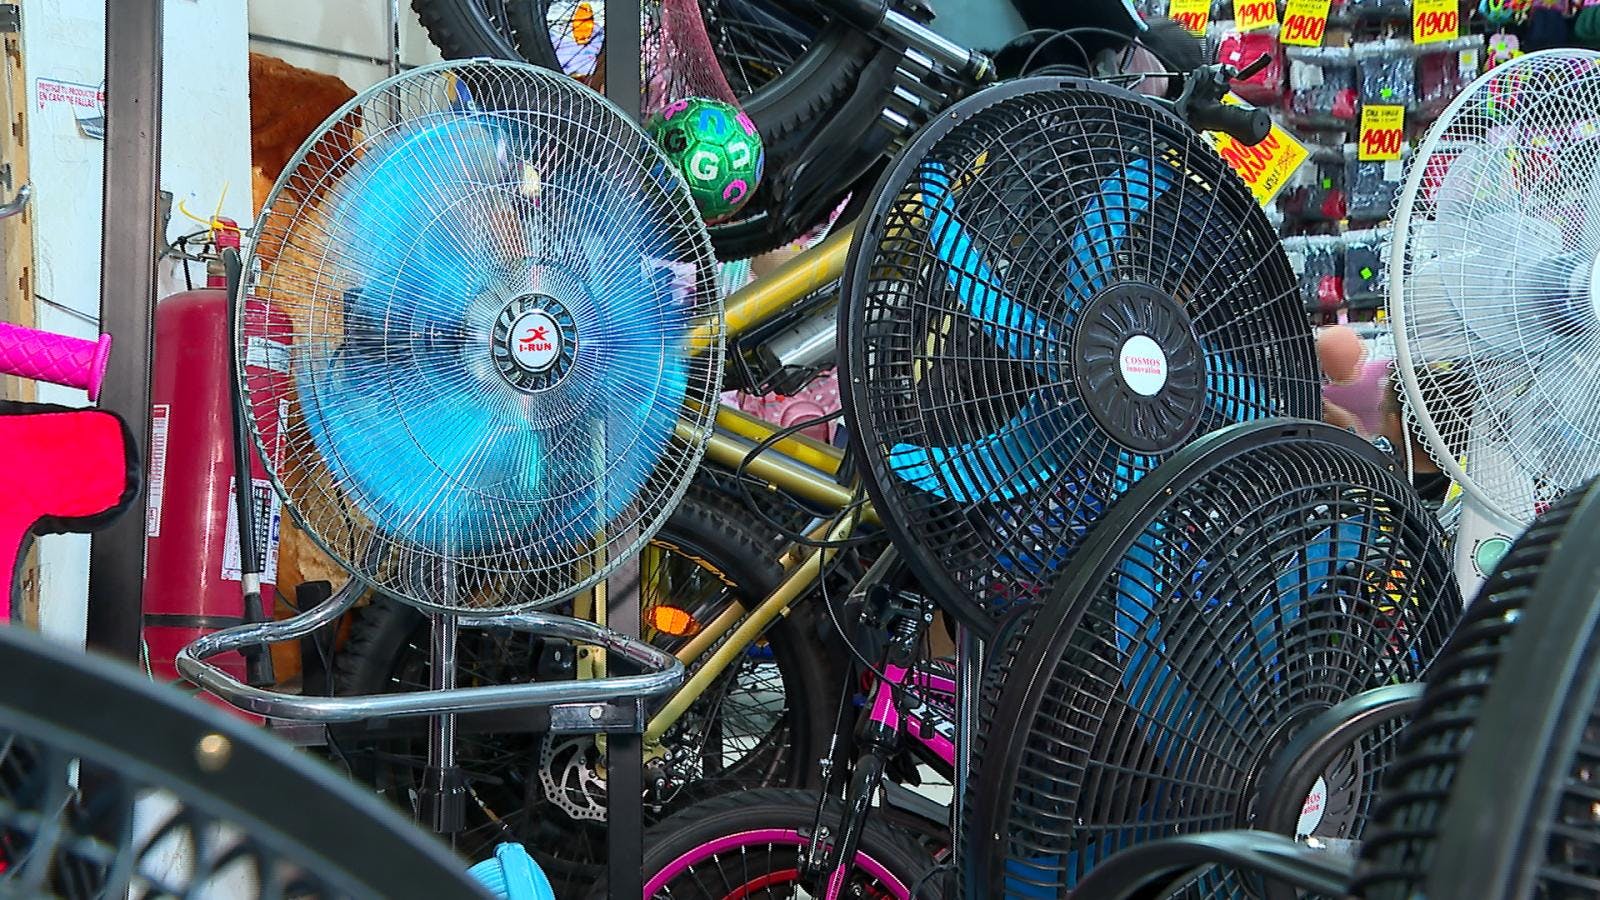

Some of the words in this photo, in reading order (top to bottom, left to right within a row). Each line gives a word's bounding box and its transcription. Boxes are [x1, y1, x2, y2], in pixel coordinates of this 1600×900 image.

[1238, 2, 1275, 27] 1900
[1416, 11, 1456, 38] 1900
[1285, 14, 1325, 41] 1900
[74, 96, 96, 108] FALLAS
[1362, 128, 1402, 155] 1900
[690, 150, 720, 181] G
[519, 342, 552, 353] I-RUN
[1125, 355, 1161, 367] COSMOS
[1126, 366, 1161, 375] innovation
